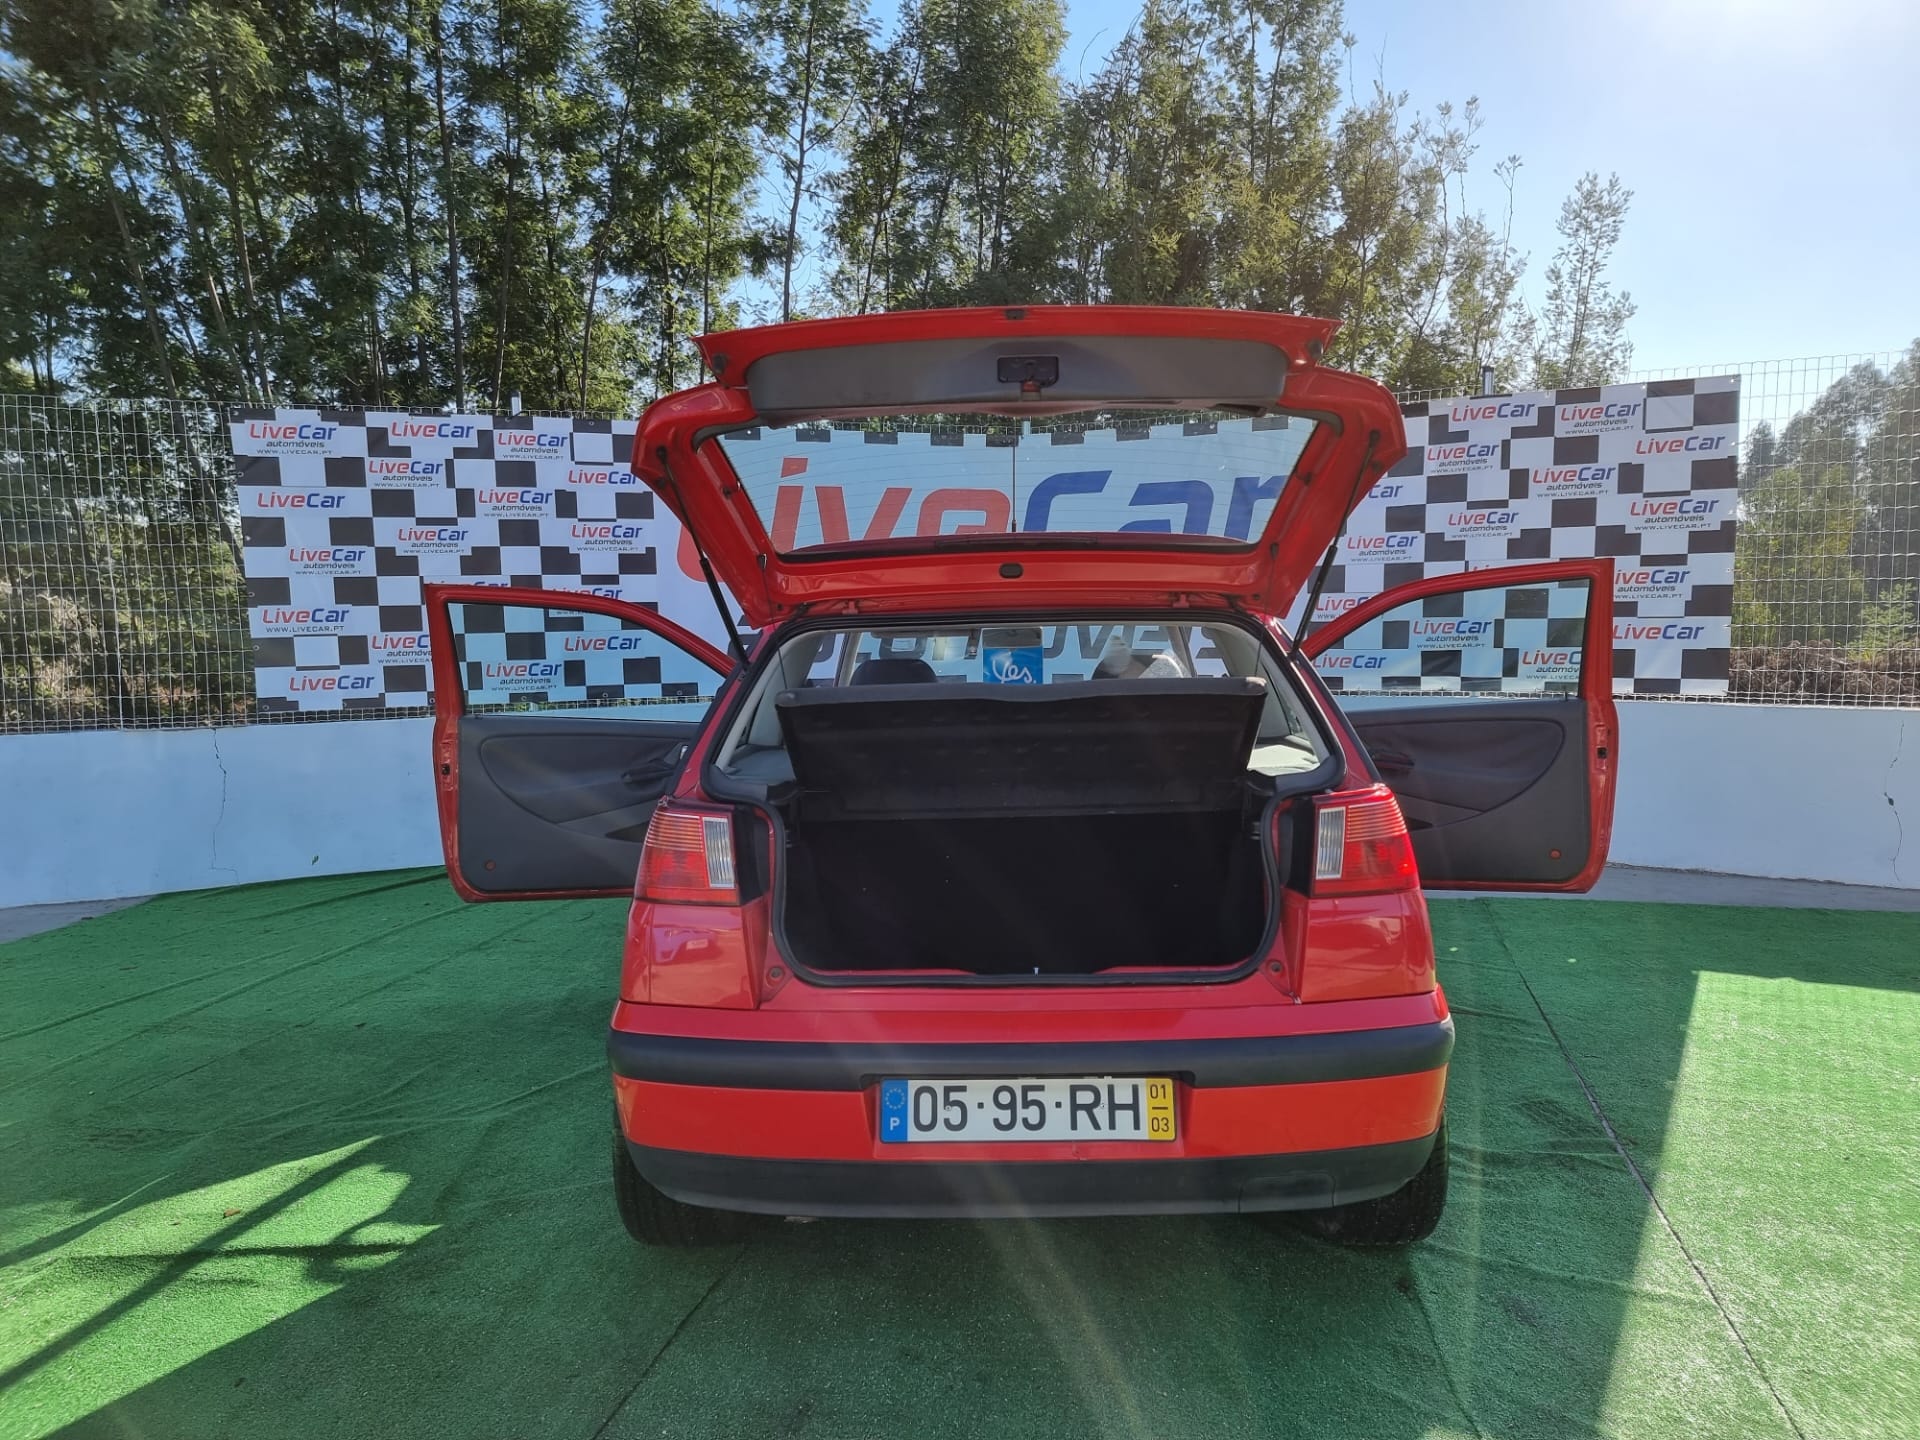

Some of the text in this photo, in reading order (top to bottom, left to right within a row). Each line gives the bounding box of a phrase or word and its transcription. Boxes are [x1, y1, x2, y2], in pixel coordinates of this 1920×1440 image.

[1452, 403, 1536, 422] LiveCar
[1561, 403, 1641, 421] LiveCar
[392, 421, 474, 438] LiveCar
[1574, 419, 1628, 427] automóveis
[250, 423, 337, 440] LiveCar
[498, 433, 568, 447] LiveCar
[1636, 436, 1725, 454] LiveCar
[1427, 444, 1499, 461] LiveCar
[369, 460, 443, 474] LiveCar
[1439, 458, 1488, 467] automóveis
[1532, 467, 1616, 483] LiveCar
[1546, 482, 1602, 490] automóveis
[257, 492, 345, 508] LiveCar
[479, 490, 553, 504] LiveCar
[1630, 499, 1720, 516] LiveCar
[1448, 512, 1519, 525] LiveCar
[1644, 515, 1705, 523] automóveis
[398, 528, 468, 542] LiveCar
[571, 524, 643, 538] LiveCar
[1347, 535, 1418, 549] LiveCar
[289, 549, 366, 561] LiveCar
[1615, 570, 1691, 584] iveCar
[263, 608, 349, 623] LiveCar
[1413, 619, 1492, 634] LiveCar
[1613, 624, 1705, 640] LiveCar
[372, 634, 429, 649] LiveC
[564, 636, 642, 651] LiveCar
[1426, 634, 1479, 642] automóveis
[1522, 650, 1581, 664] LiveC
[485, 661, 562, 677] LiveCar
[289, 676, 375, 692] LiveCar
[500, 677, 551, 685] automóveis
[1150, 1084, 1166, 1100] 01
[890, 1117, 900, 1130] P
[1152, 1117, 1169, 1132] 03
